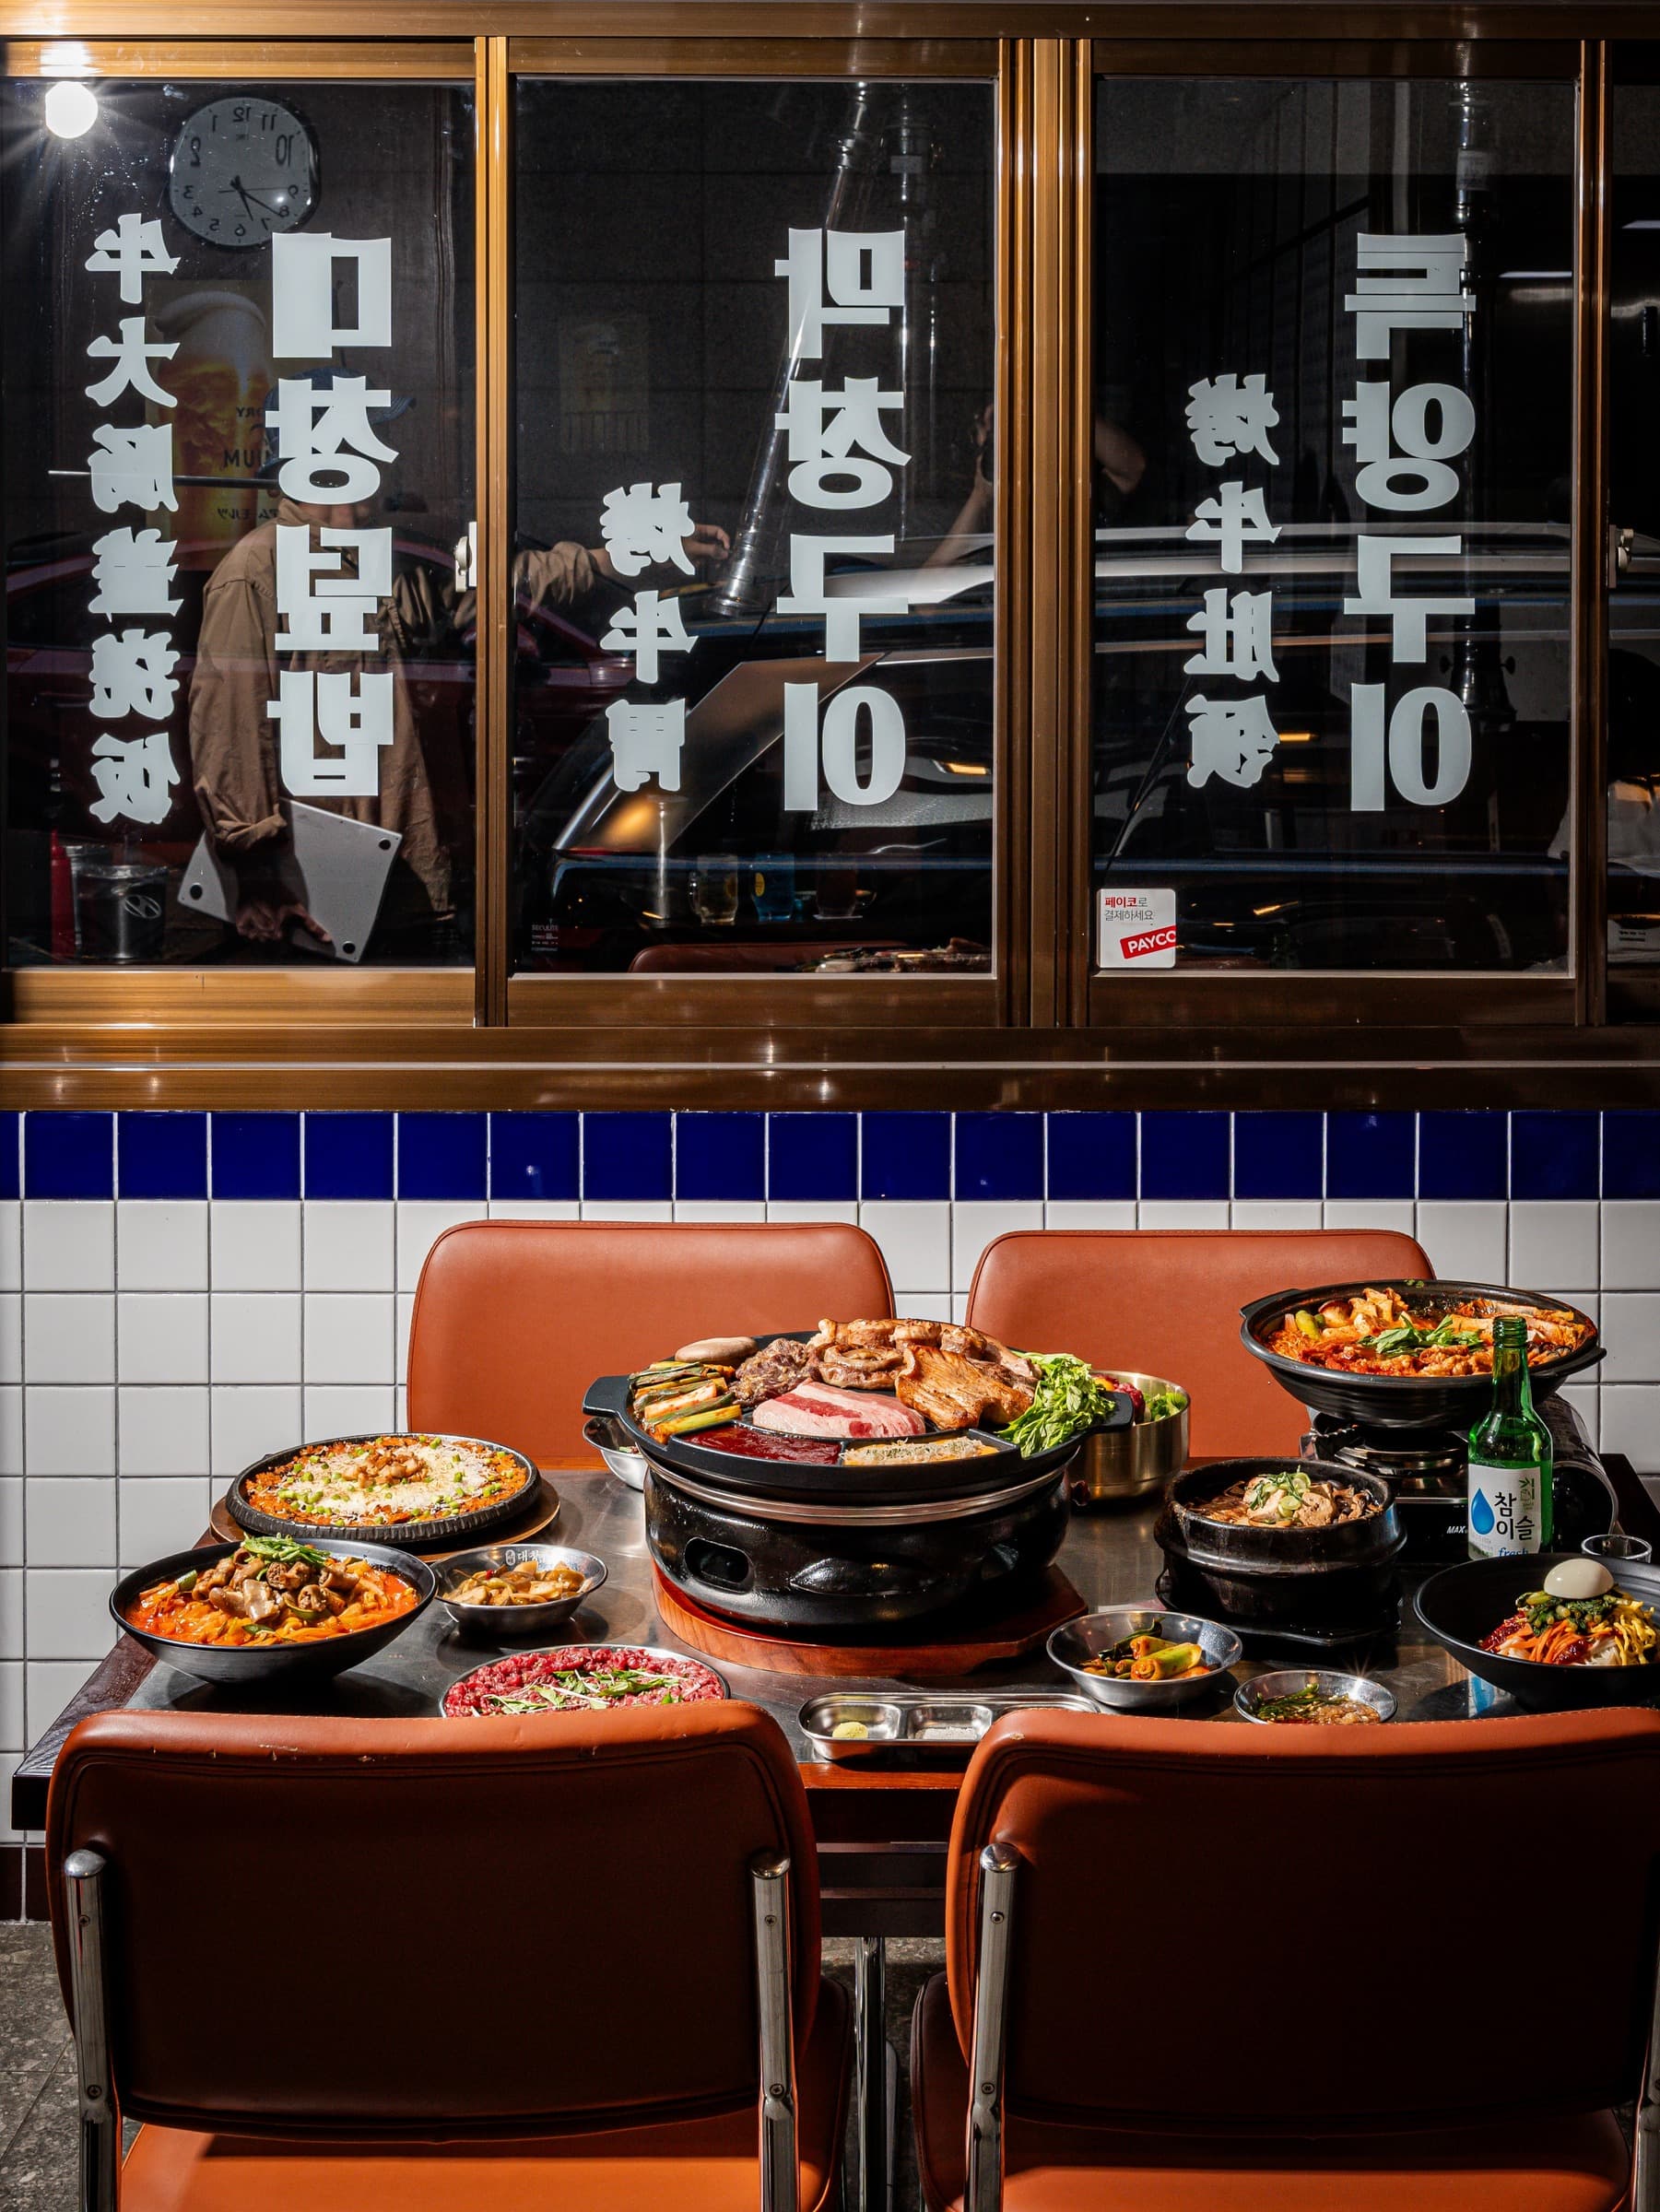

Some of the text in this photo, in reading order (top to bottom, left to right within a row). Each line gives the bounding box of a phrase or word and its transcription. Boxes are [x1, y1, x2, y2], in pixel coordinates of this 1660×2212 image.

[1105, 897, 1148, 908] 페이코로
[1105, 910, 1154, 922] 결제하세요
[1127, 930, 1176, 953] PAYCO
[1494, 1491, 1517, 1517] 참
[1496, 1515, 1536, 1541] 이슬
